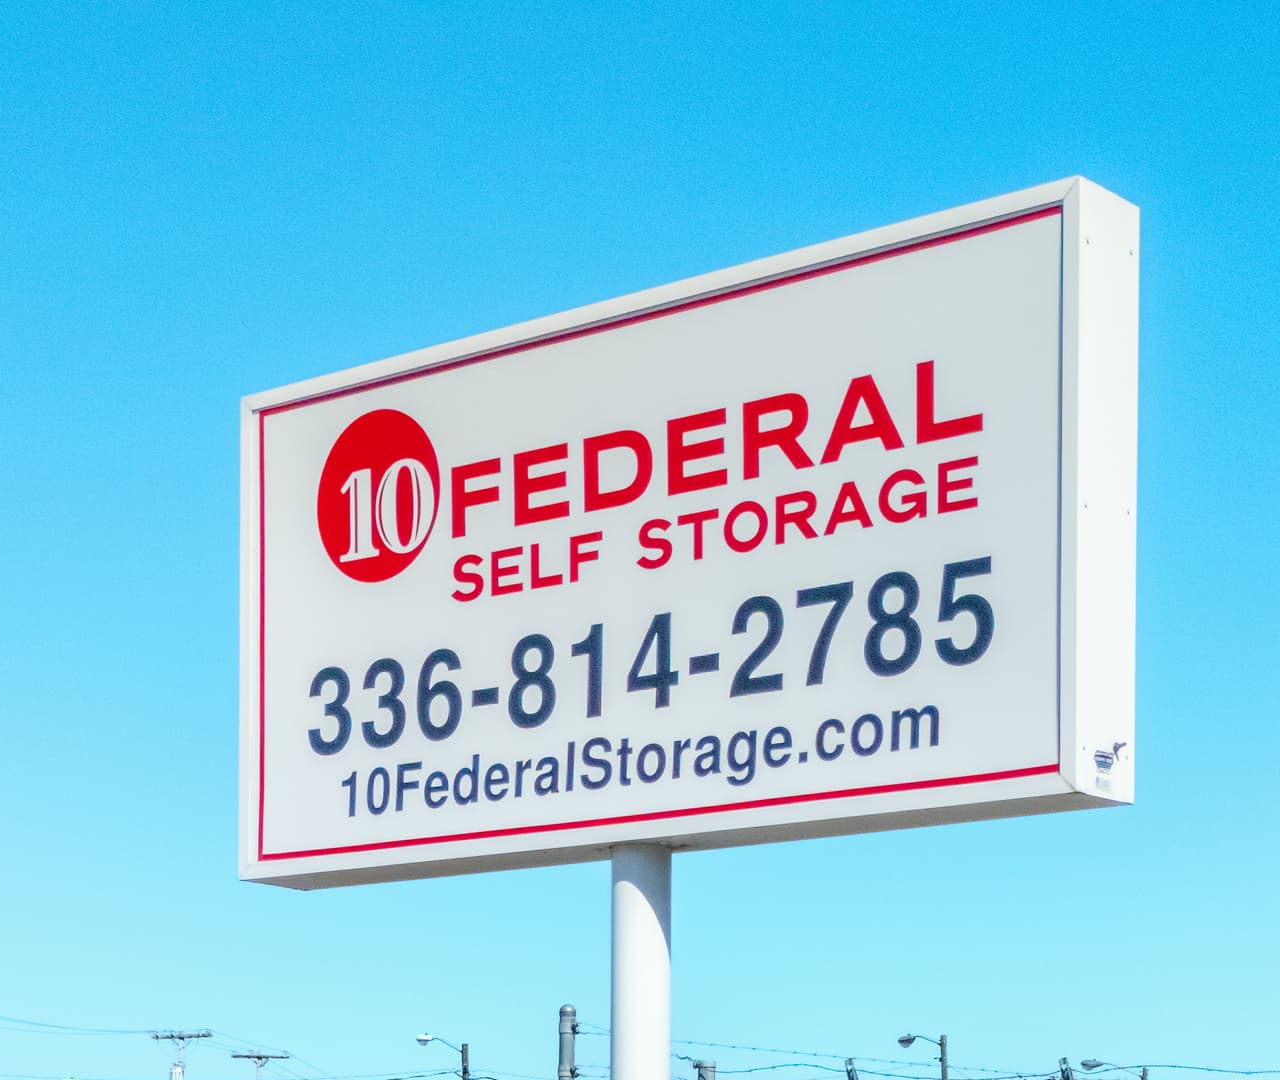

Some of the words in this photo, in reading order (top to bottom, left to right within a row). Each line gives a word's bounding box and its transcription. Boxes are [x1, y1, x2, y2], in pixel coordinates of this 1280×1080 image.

[339, 456, 438, 564] 10
[450, 359, 984, 539] FEDERAL
[451, 530, 604, 603] SELF
[637, 455, 980, 571] STORAGE
[307, 555, 996, 757] 336-814-2785
[340, 704, 941, 818] 10FederalStorage.com
